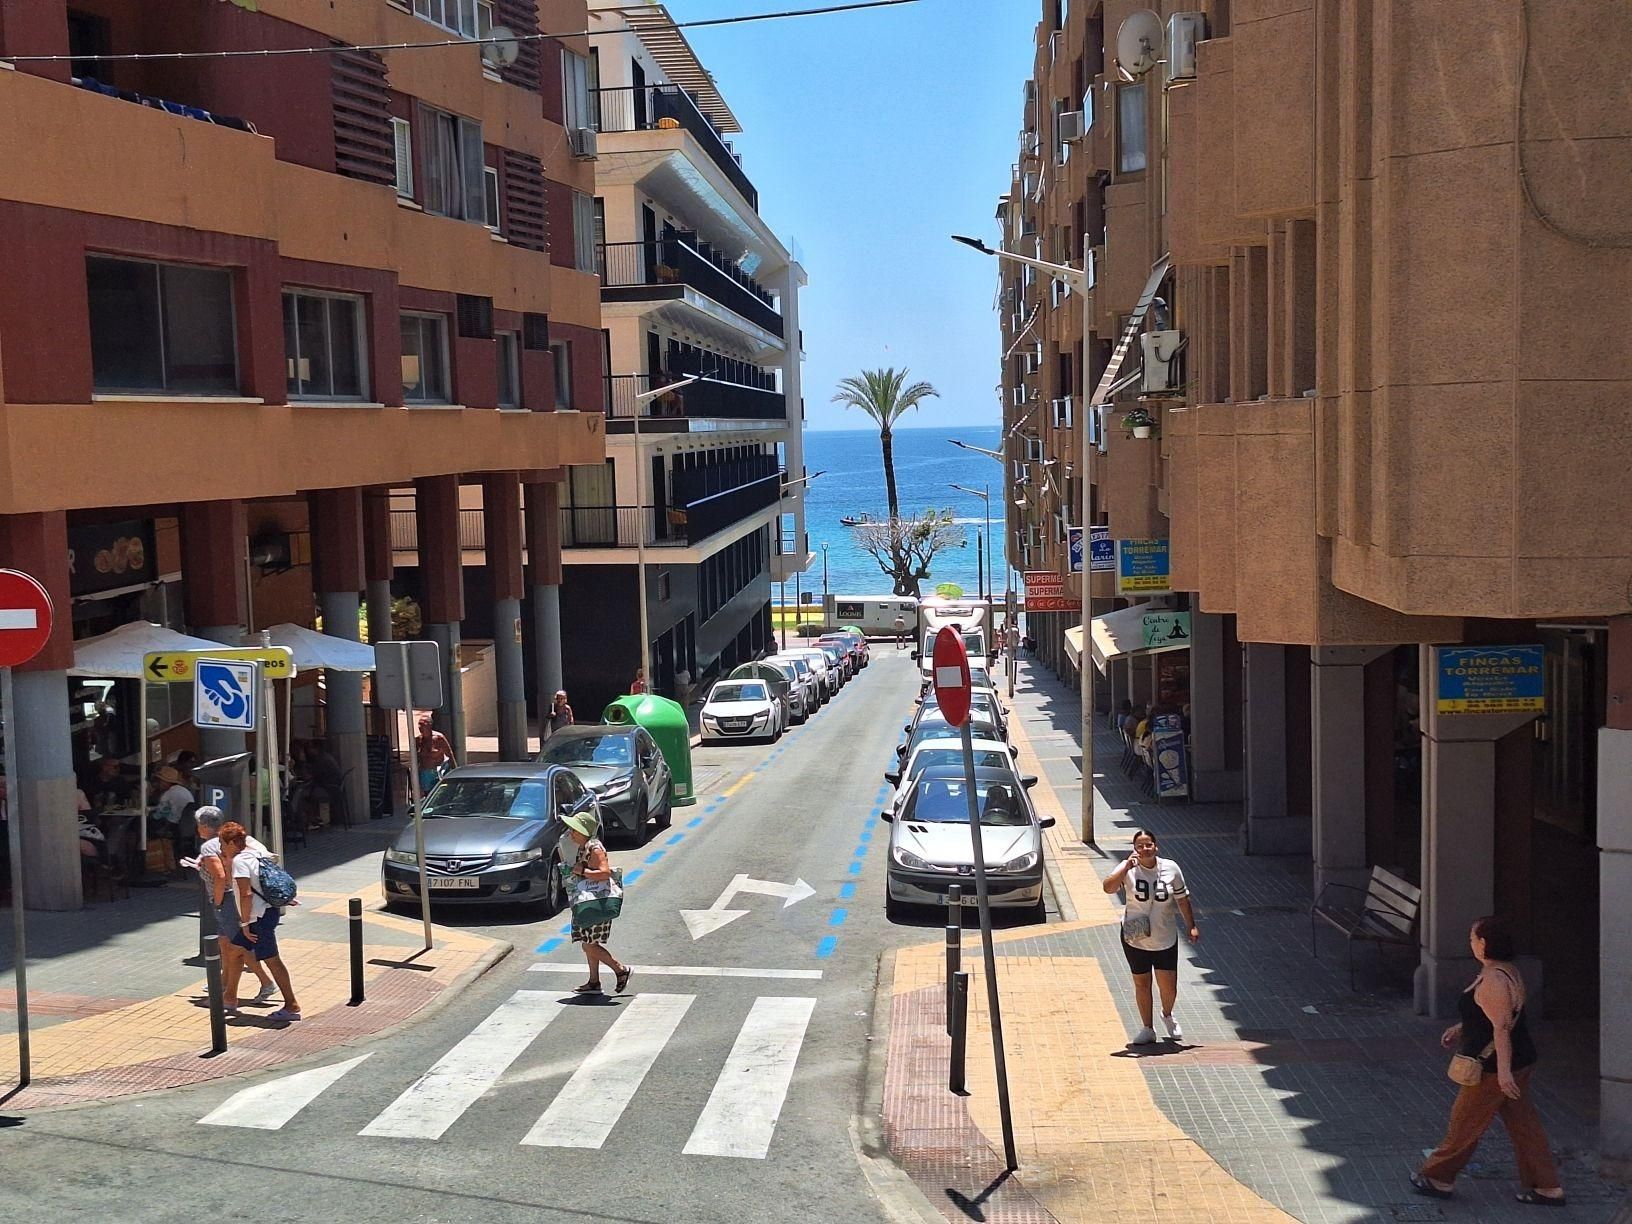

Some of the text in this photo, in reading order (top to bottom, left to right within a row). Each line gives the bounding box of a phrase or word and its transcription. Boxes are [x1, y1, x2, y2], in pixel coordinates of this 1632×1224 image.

[1122, 546, 1167, 554] TORREMAR
[1026, 575, 1063, 584] SUPERME
[1459, 657, 1521, 666] FINCAS
[1444, 665, 1539, 676] TORREMAR
[212, 788, 224, 806] P
[433, 878, 475, 888] 7107 FNL
